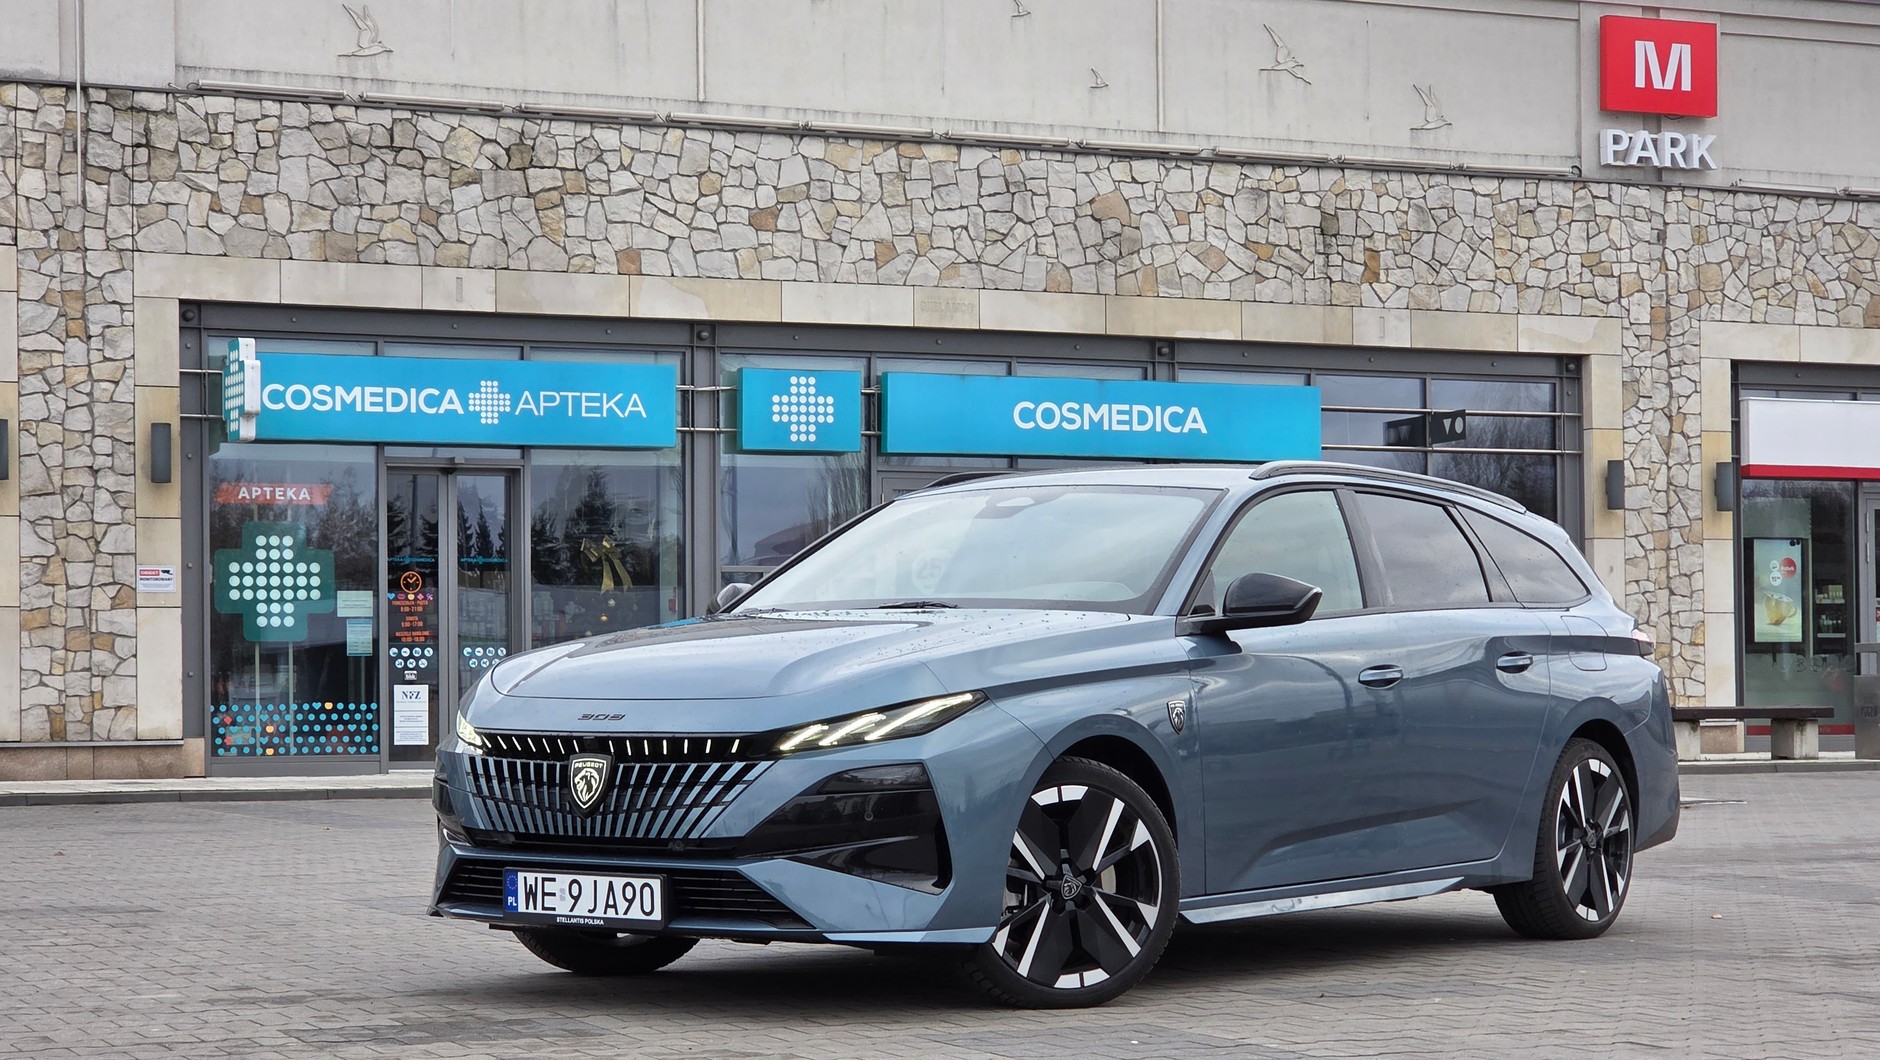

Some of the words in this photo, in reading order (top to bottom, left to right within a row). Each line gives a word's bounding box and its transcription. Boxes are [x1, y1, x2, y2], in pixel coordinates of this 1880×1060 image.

[1635, 40, 1692, 92] M
[1601, 129, 1717, 169] PARK
[262, 383, 464, 415] COSMEDICA
[515, 391, 647, 418] APTEKA
[1013, 401, 1208, 434] COSMEDICA
[238, 487, 311, 500] APTEKA
[401, 690, 421, 700] NFZ
[577, 713, 626, 721] 308
[508, 896, 517, 907] PL
[523, 876, 557, 912] WE
[568, 878, 655, 917] 9JA90
[556, 916, 585, 924] STELLANTIS
[584, 918, 604, 926] POLSKA
